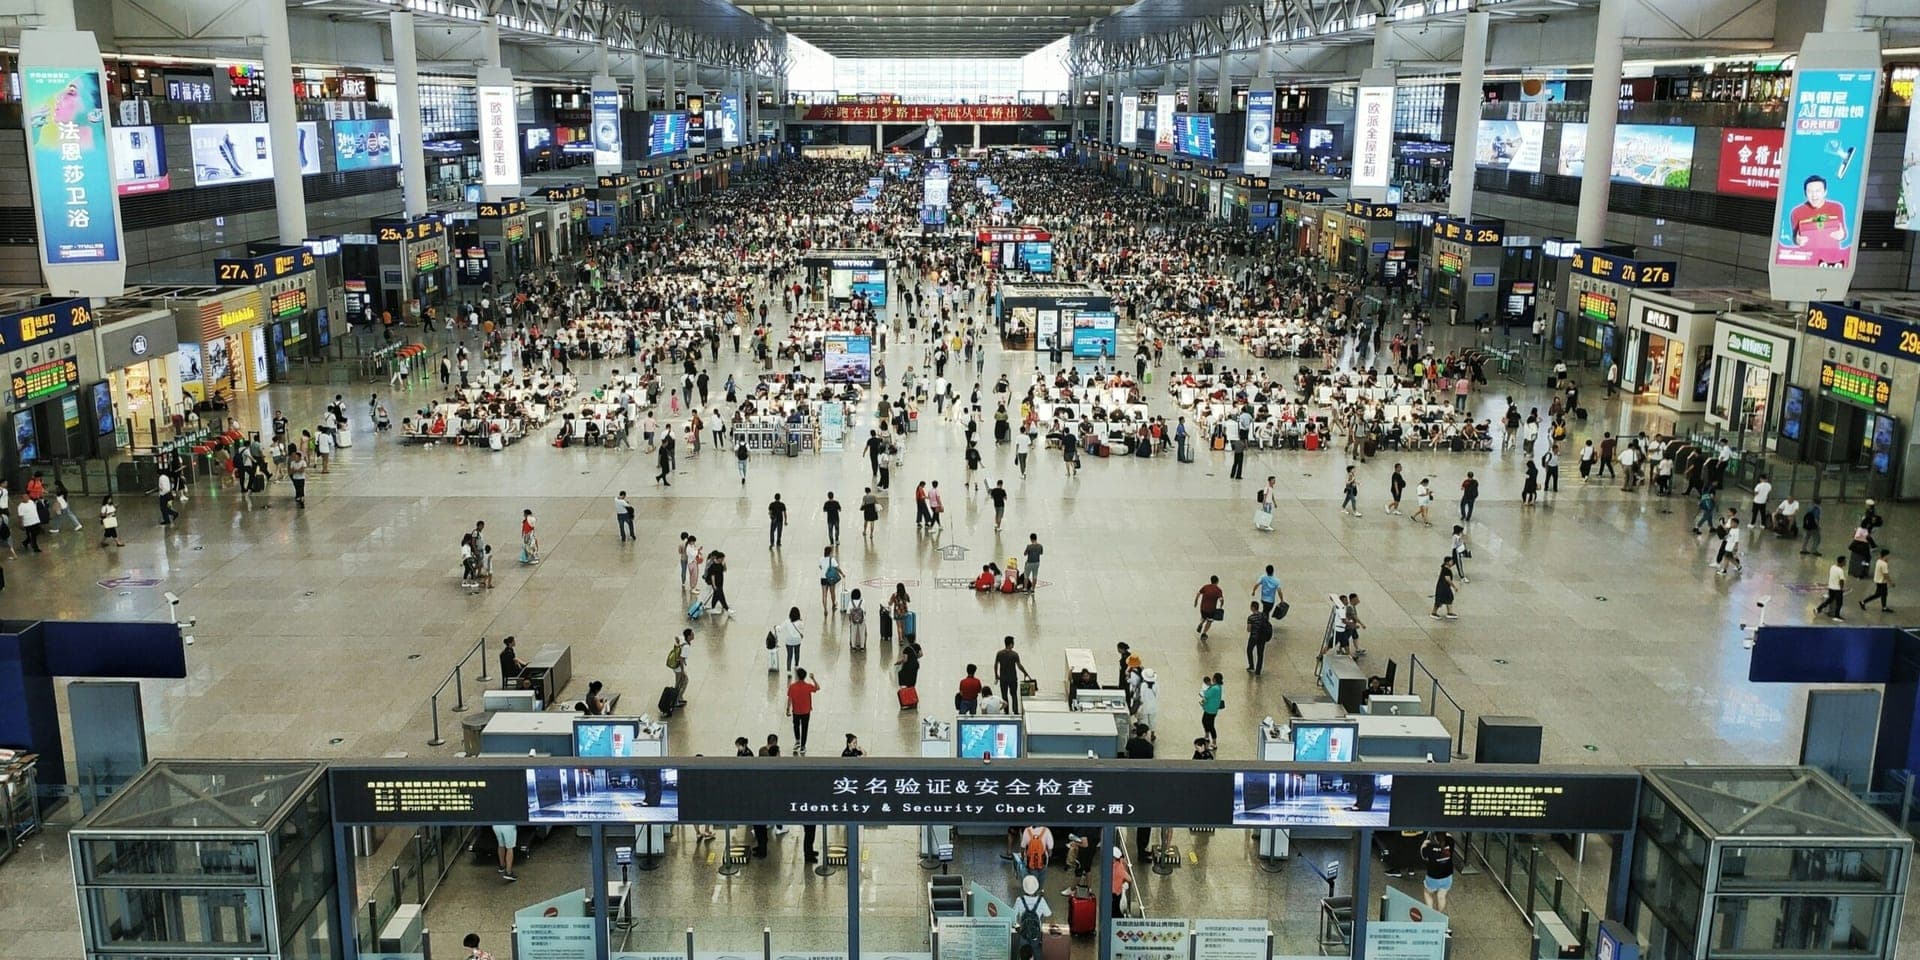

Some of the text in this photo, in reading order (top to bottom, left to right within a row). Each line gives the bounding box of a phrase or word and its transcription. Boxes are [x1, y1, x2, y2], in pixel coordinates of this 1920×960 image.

[1363, 102, 1380, 177] 欧派全屋定制
[58, 121, 90, 228] 法恩莎卫浴
[548, 190, 565, 200] 21A
[480, 206, 498, 216] 23A
[1375, 207, 1393, 218] 23B
[380, 228, 403, 240] 25A
[1477, 230, 1499, 242] 25B
[220, 264, 249, 279] 27A
[254, 263, 268, 279] 27A
[1622, 264, 1636, 282] 27B
[1642, 267, 1670, 283] 27B
[71, 306, 92, 326] 28A
[1807, 309, 1828, 330] 28B
[833, 777, 1094, 796] 实名验证&安全检查
[790, 802, 870, 814] Identity
[882, 803, 891, 813] &
[902, 802, 984, 814] Security
[996, 802, 1046, 813] Check
